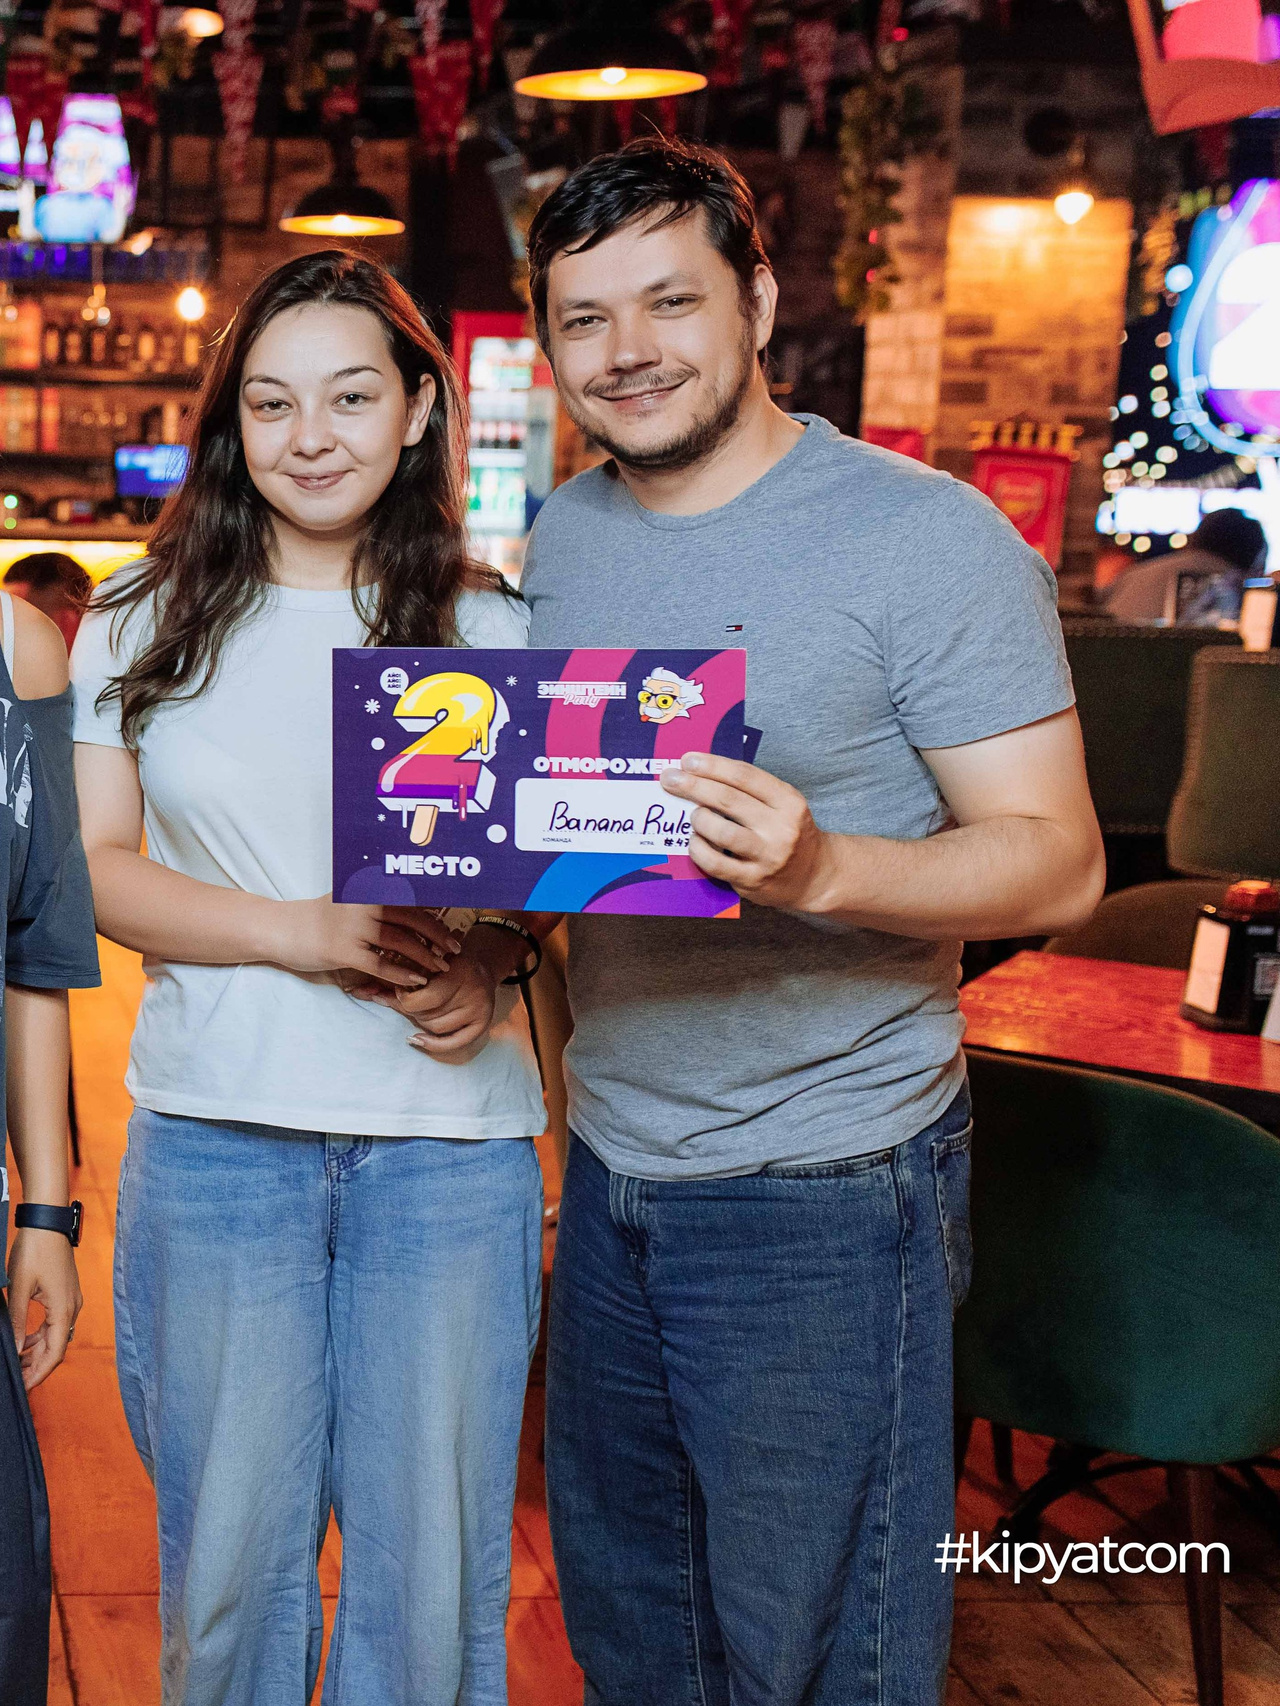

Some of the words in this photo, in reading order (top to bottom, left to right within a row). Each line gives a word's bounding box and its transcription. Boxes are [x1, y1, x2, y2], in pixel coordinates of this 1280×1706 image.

[563, 693, 601, 708] Party
[376, 672, 510, 813] 2
[549, 801, 634, 833] Banana
[642, 804, 696, 835] Rule
[385, 854, 481, 877] МЕСТО
